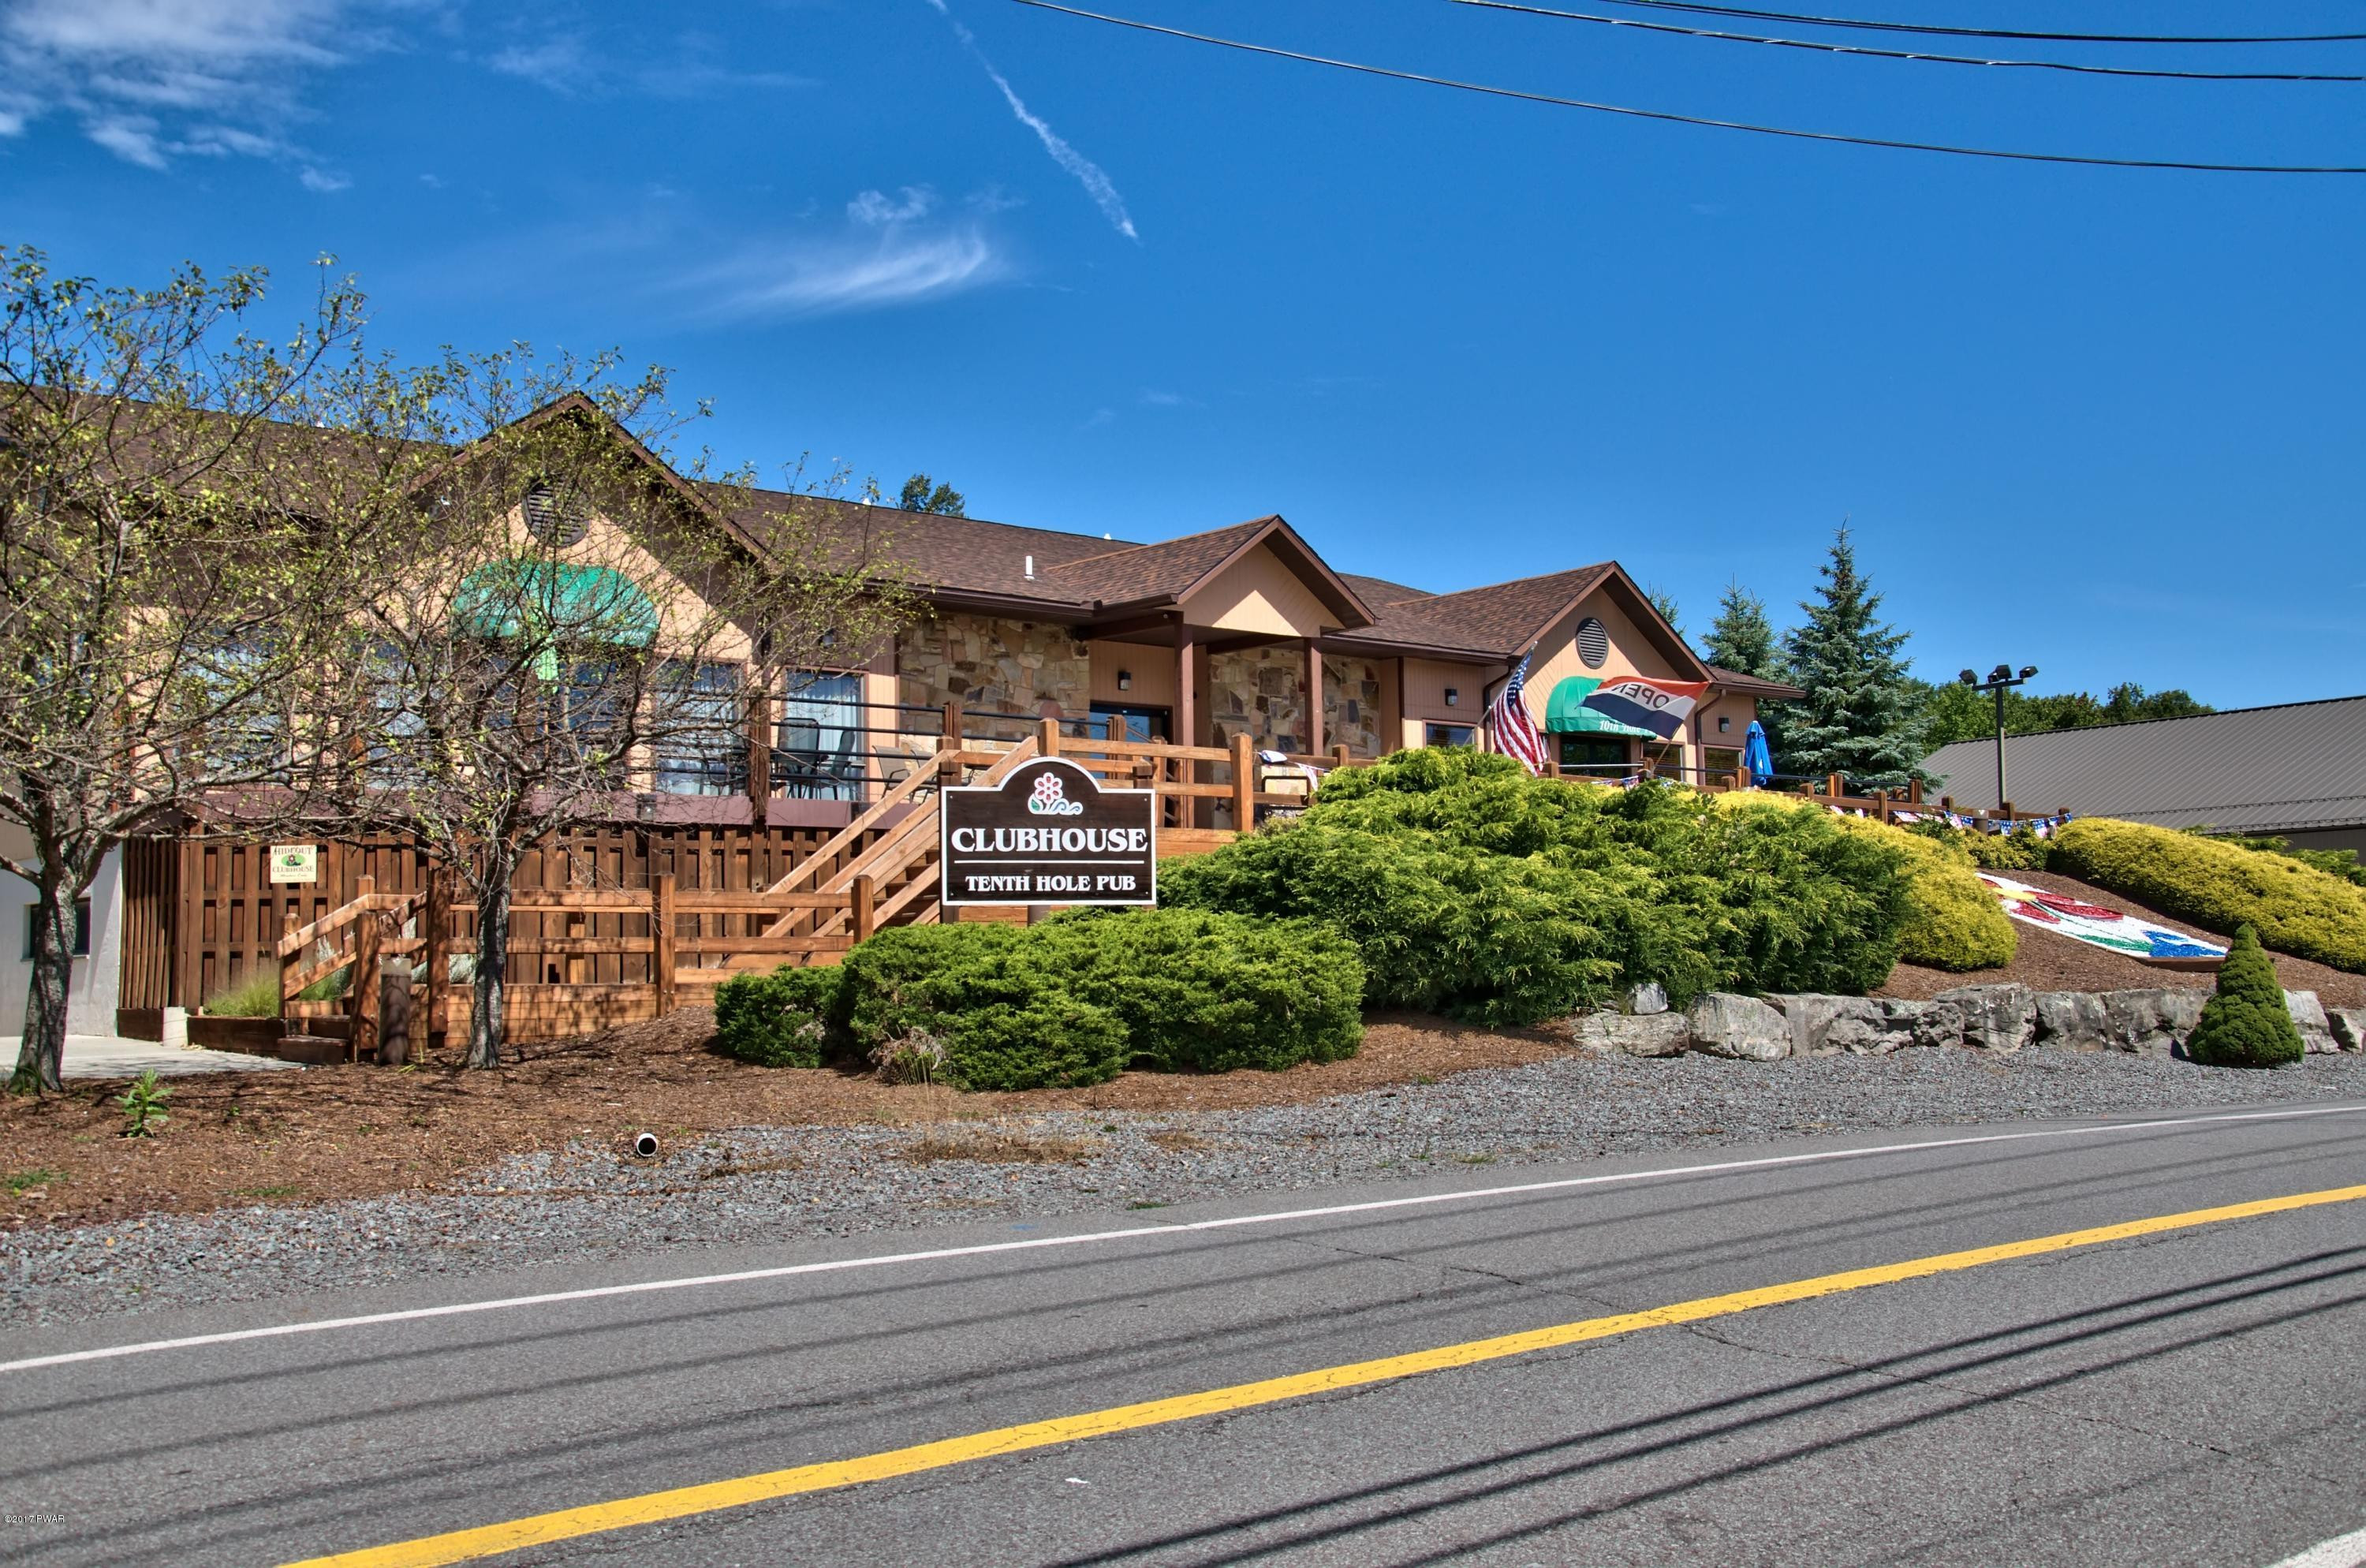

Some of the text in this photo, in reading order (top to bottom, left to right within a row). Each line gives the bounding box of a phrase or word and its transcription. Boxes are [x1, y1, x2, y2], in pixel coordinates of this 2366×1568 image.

[951, 827, 1148, 852] CLUBHOUSE
[965, 875, 1136, 891] TENTH HOLE PUB
